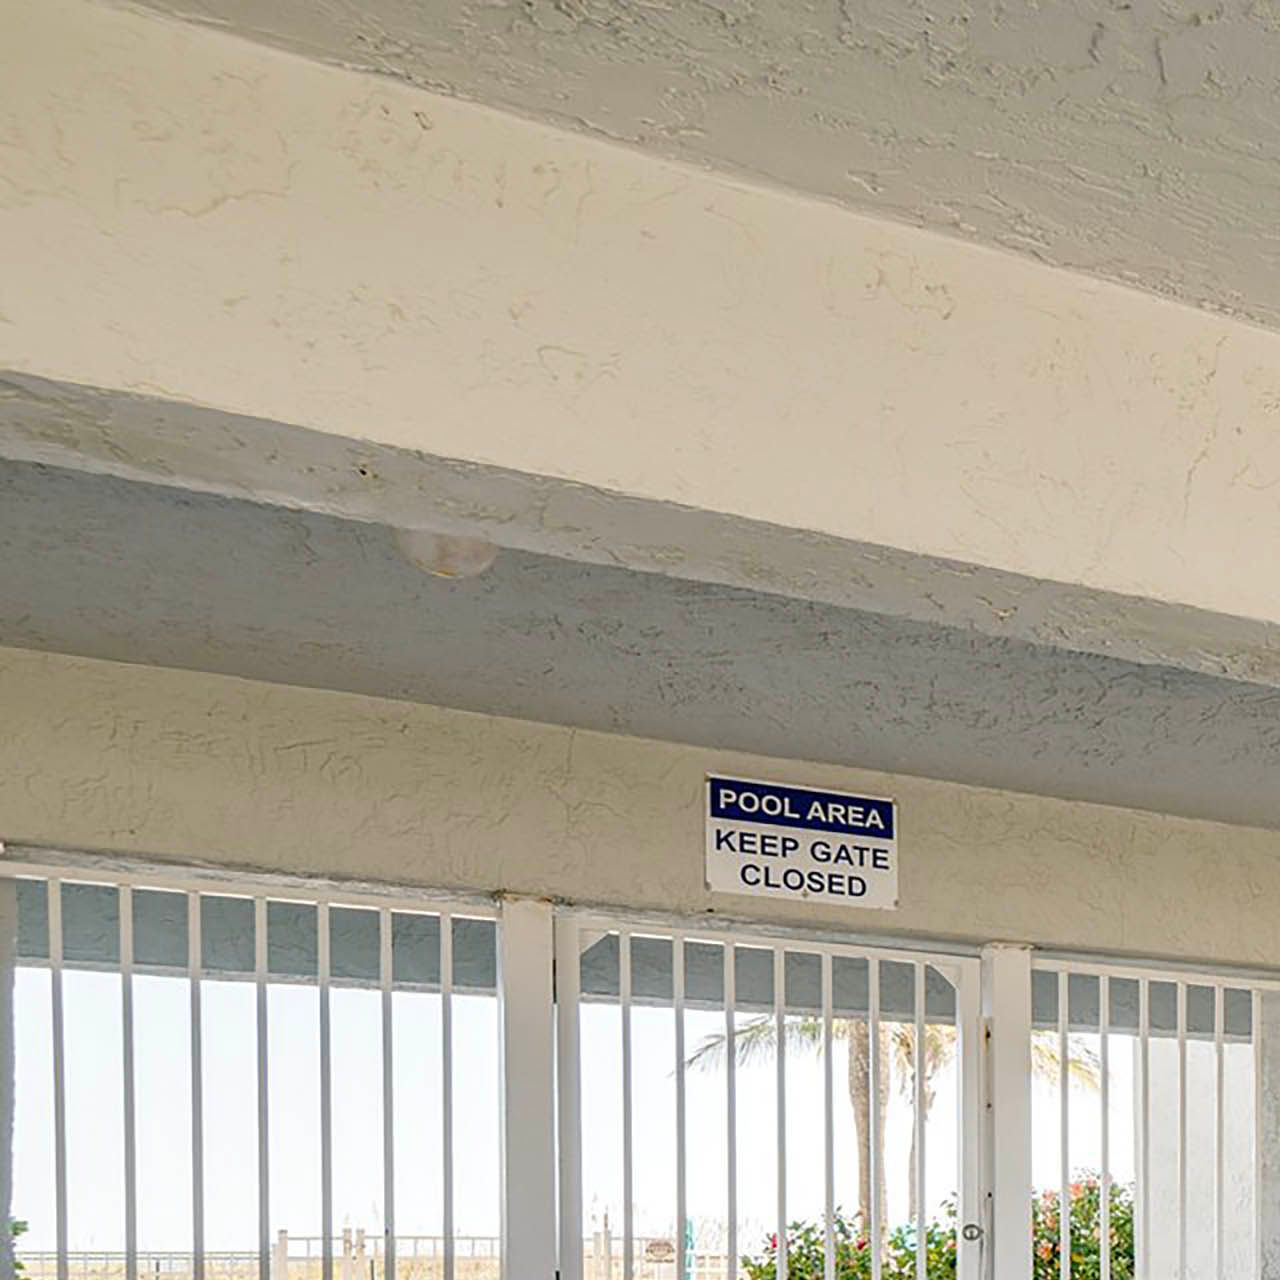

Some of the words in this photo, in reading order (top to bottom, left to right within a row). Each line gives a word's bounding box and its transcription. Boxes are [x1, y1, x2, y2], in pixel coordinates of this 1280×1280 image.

[718, 788, 800, 819] POOL
[806, 801, 885, 830] AREA
[715, 828, 799, 858] KEEP
[810, 841, 890, 870] GATE
[740, 864, 867, 897] CLOSED
